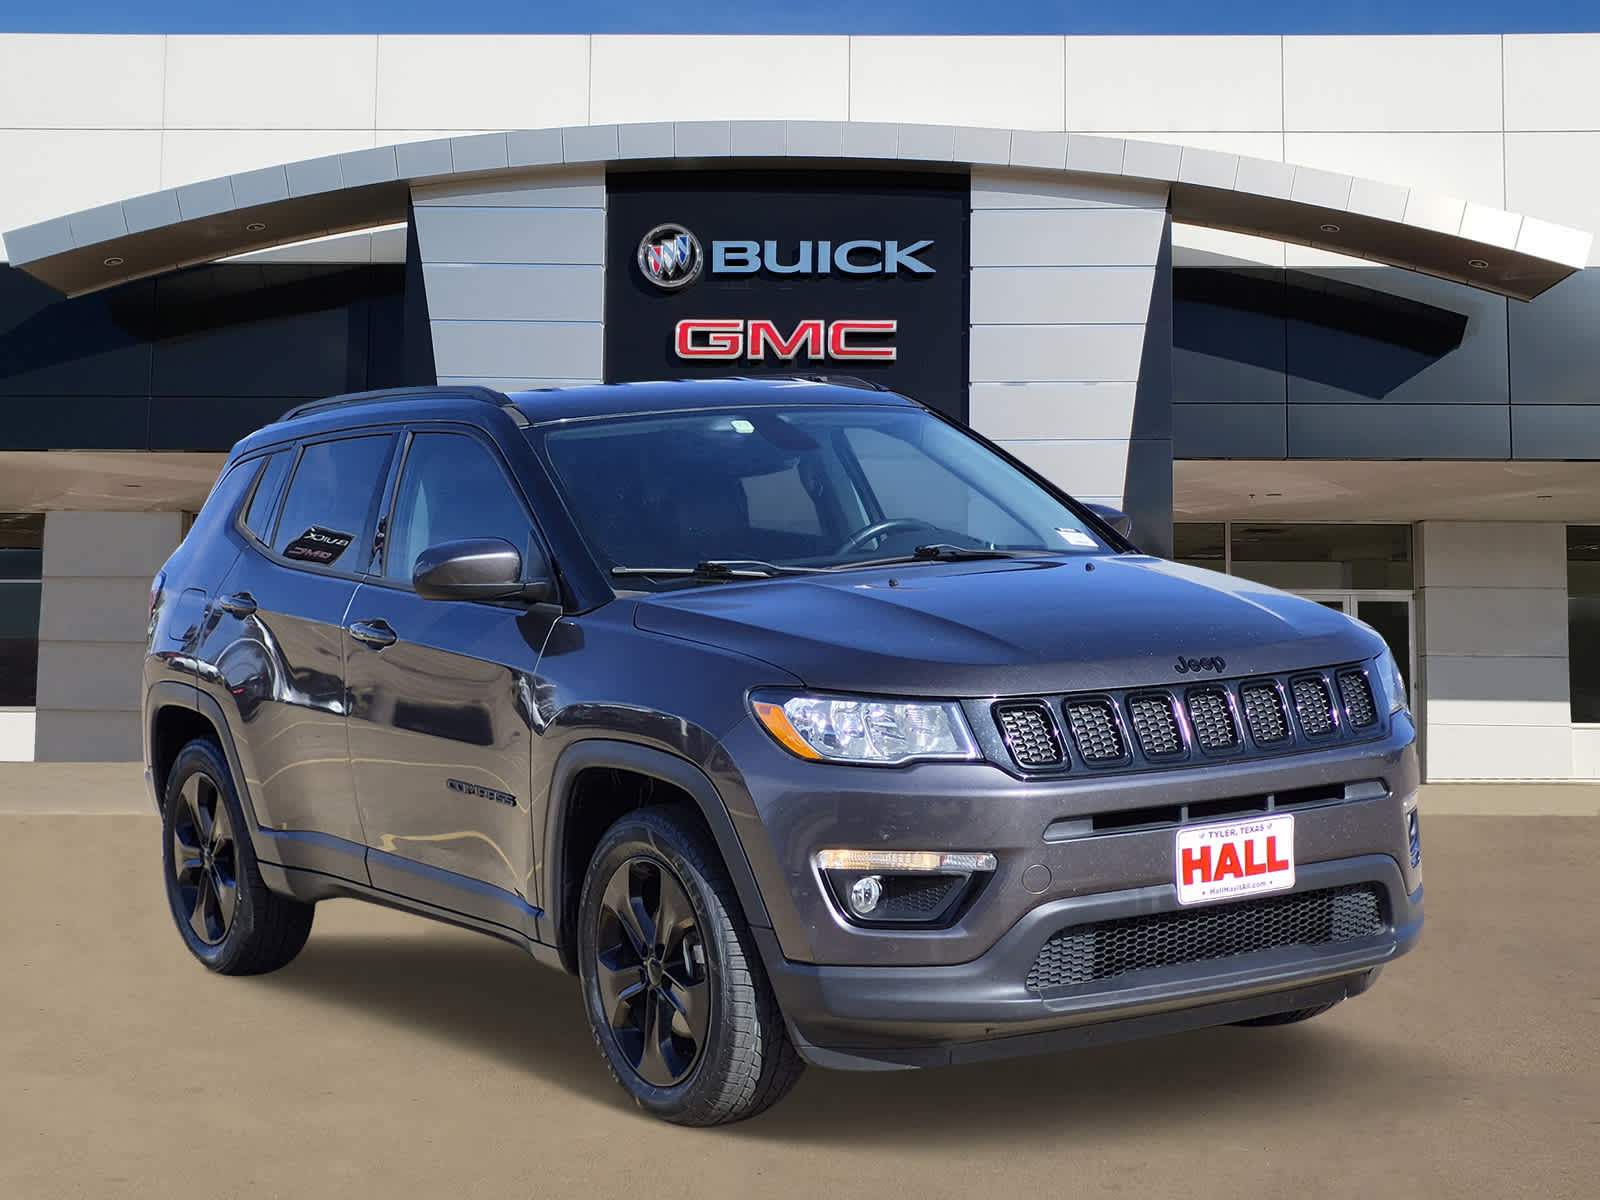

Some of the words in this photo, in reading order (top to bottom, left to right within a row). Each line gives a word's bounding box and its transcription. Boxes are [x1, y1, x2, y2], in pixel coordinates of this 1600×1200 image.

[712, 240, 937, 273] BUICK
[675, 319, 897, 361] GMC
[1174, 656, 1226, 674] Jeep
[1208, 828, 1239, 839] TYLER,
[1240, 823, 1265, 835] TEXAS
[1182, 835, 1289, 886] HALL
